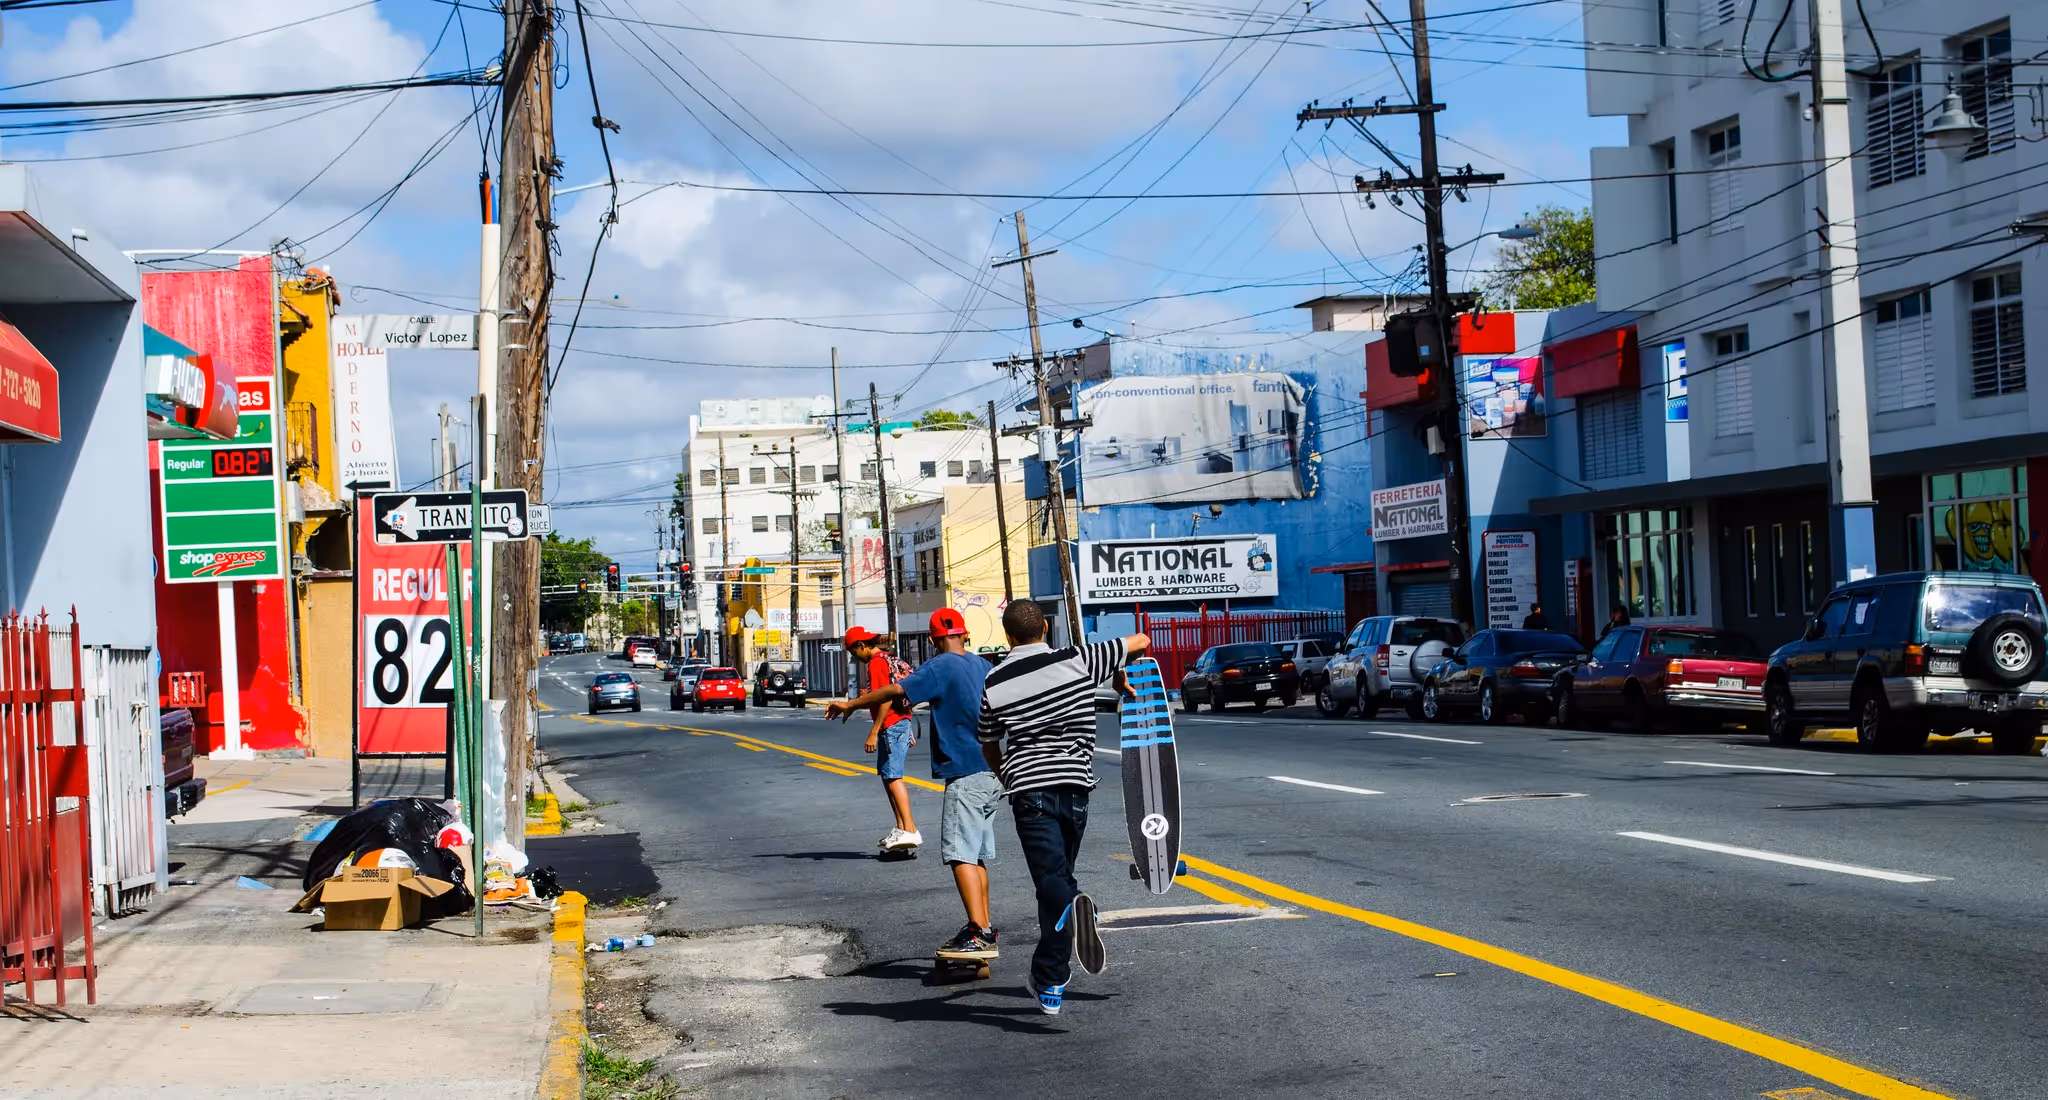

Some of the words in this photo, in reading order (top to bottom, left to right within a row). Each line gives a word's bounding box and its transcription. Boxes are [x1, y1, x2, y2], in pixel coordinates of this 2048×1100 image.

[409, 316, 436, 324] CALLE
[385, 332, 422, 344] Victor
[429, 331, 468, 344] Lopez
[0, 365, 41, 410] -727-5820
[1199, 384, 1236, 395] office.
[167, 458, 205, 472] Regular
[347, 461, 387, 469] Abierto
[1373, 483, 1443, 505] FERRETERIA
[419, 505, 512, 528] TRANITO
[1373, 499, 1444, 529] NATIONAL
[1374, 528, 1400, 539] LUMBER
[1407, 522, 1445, 535] HARDWARE
[1092, 541, 1233, 574] NATIONAL
[372, 568, 473, 602] REGULR
[1096, 576, 1142, 588] LUMBER
[1147, 575, 1156, 586] &
[1161, 572, 1226, 586] HARDWARE
[1094, 588, 1160, 599] ENTRADA
[1178, 585, 1238, 595] PARKING
[372, 617, 455, 706] 82
